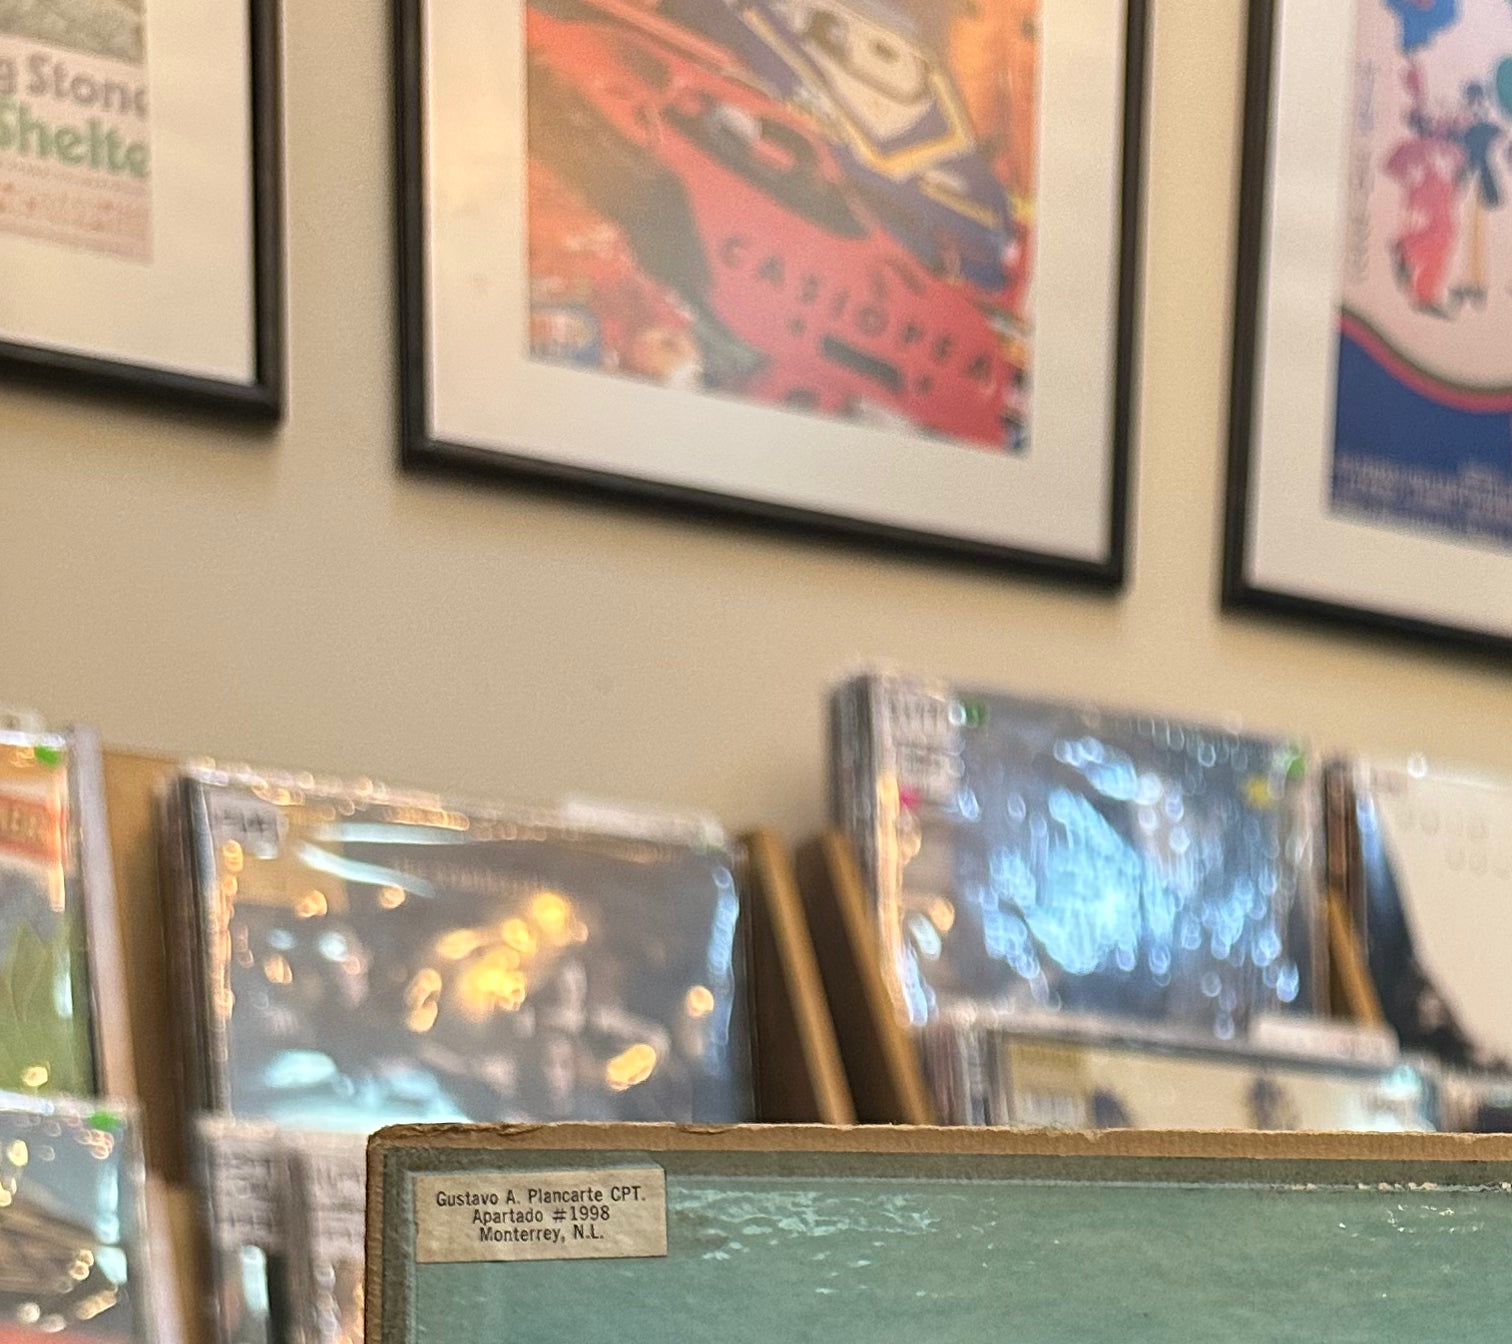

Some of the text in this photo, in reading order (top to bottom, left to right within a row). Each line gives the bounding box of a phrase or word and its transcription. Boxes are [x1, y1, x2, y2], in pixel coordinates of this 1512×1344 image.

[436, 1185, 647, 1207] Gustavo A. Plancarte CPT.
[472, 1208, 544, 1226] Apartado
[479, 1223, 605, 1243] Monterrey, N.L.
